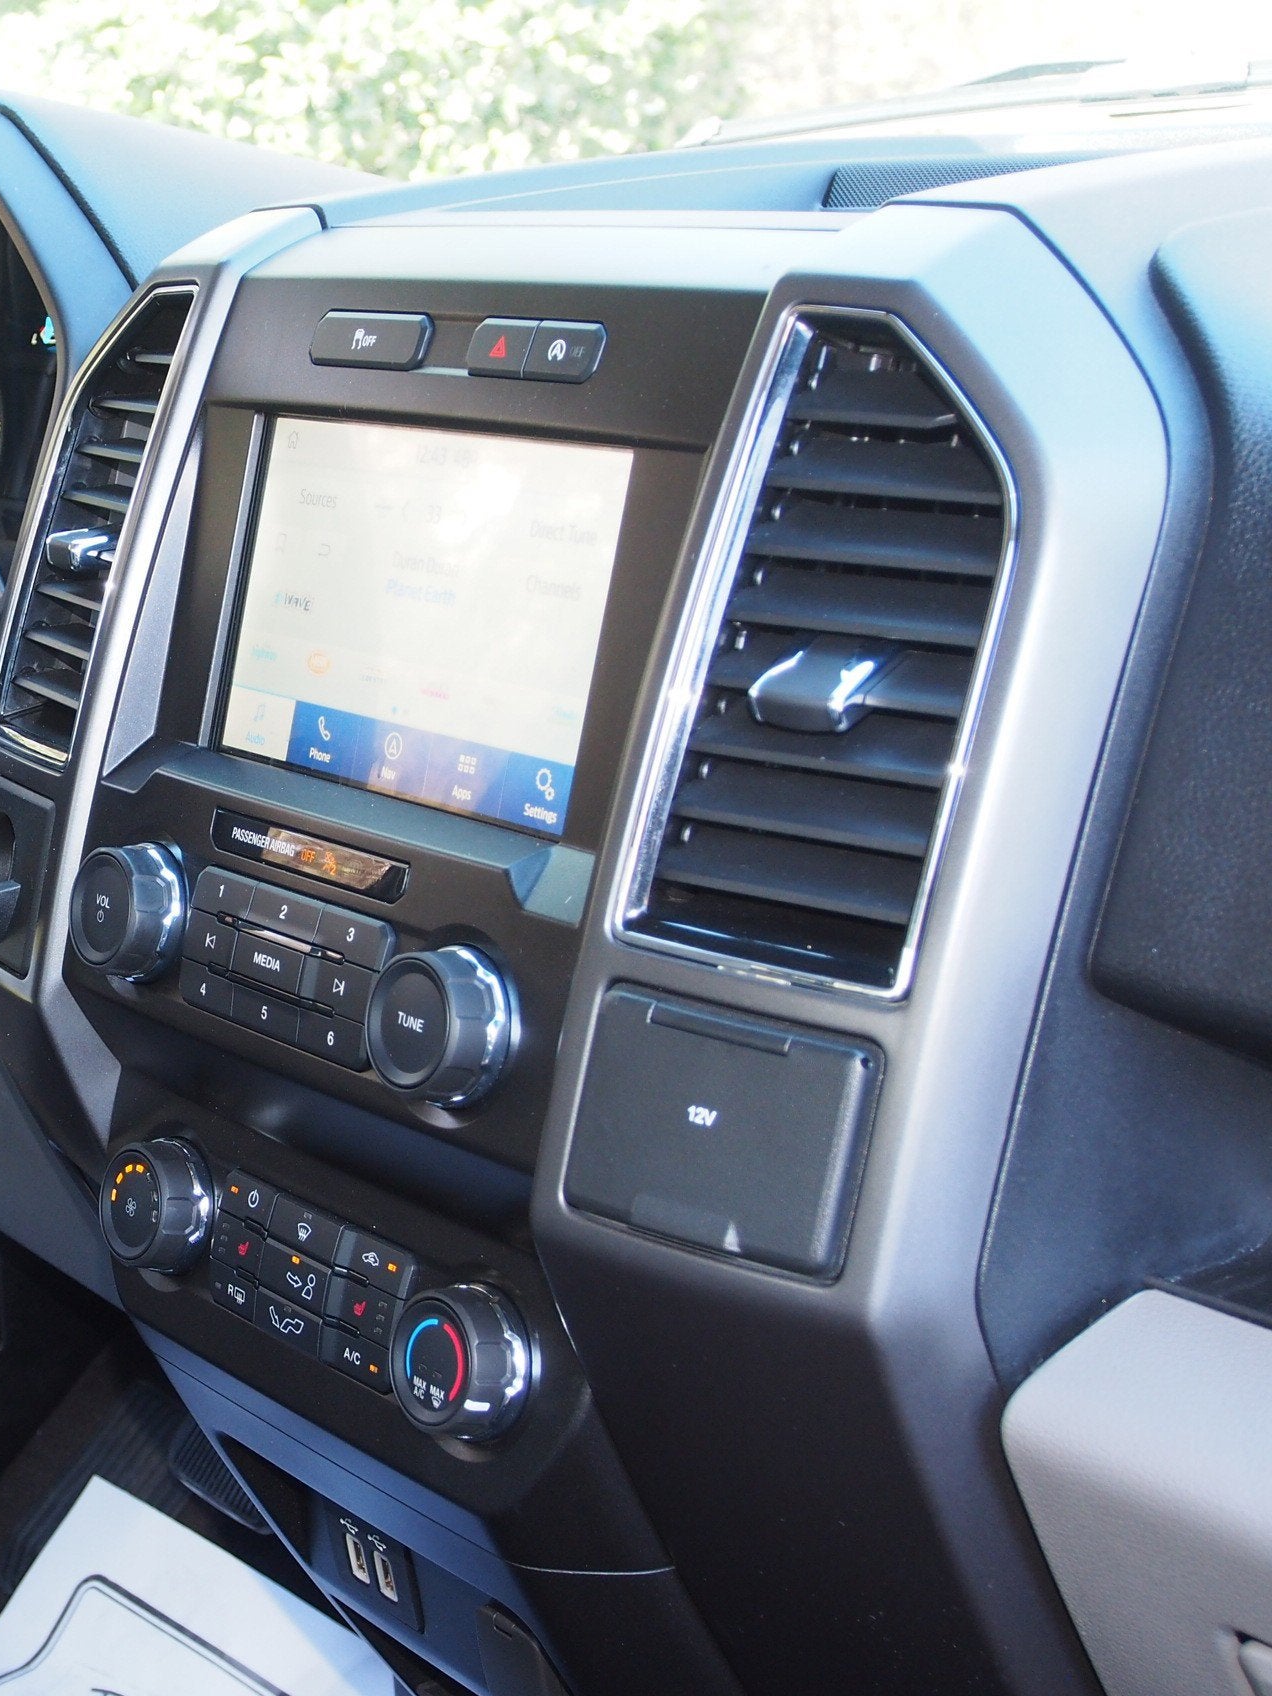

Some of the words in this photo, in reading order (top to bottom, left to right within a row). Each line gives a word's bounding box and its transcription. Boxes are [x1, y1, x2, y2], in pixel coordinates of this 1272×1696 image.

[362, 335, 377, 347] OFF
[299, 488, 337, 509] Sources
[529, 519, 565, 543] Direct
[568, 523, 597, 546] Tune
[526, 575, 581, 601] Channels
[308, 747, 331, 763] Phone
[381, 765, 396, 780] Nav
[452, 784, 472, 801] Apps
[523, 803, 557, 823] Settings
[231, 826, 269, 850] PASSENGER
[269, 838, 296, 857] AIRBAG
[300, 848, 316, 863] OFF
[217, 884, 225, 898] 1
[96, 893, 111, 909] VOL
[279, 905, 287, 920] 2
[346, 927, 354, 943] 3
[253, 951, 281, 973] MEDIA
[199, 982, 206, 997] 4
[260, 1006, 268, 1021] 5
[397, 1011, 424, 1033] TUNE
[327, 1031, 335, 1047] 6
[687, 1105, 718, 1127] 12V
[343, 1347, 361, 1365] A/C
[413, 1375, 427, 1391] MAX
[413, 1386, 425, 1400] A/C
[429, 1384, 445, 1401] MAX
